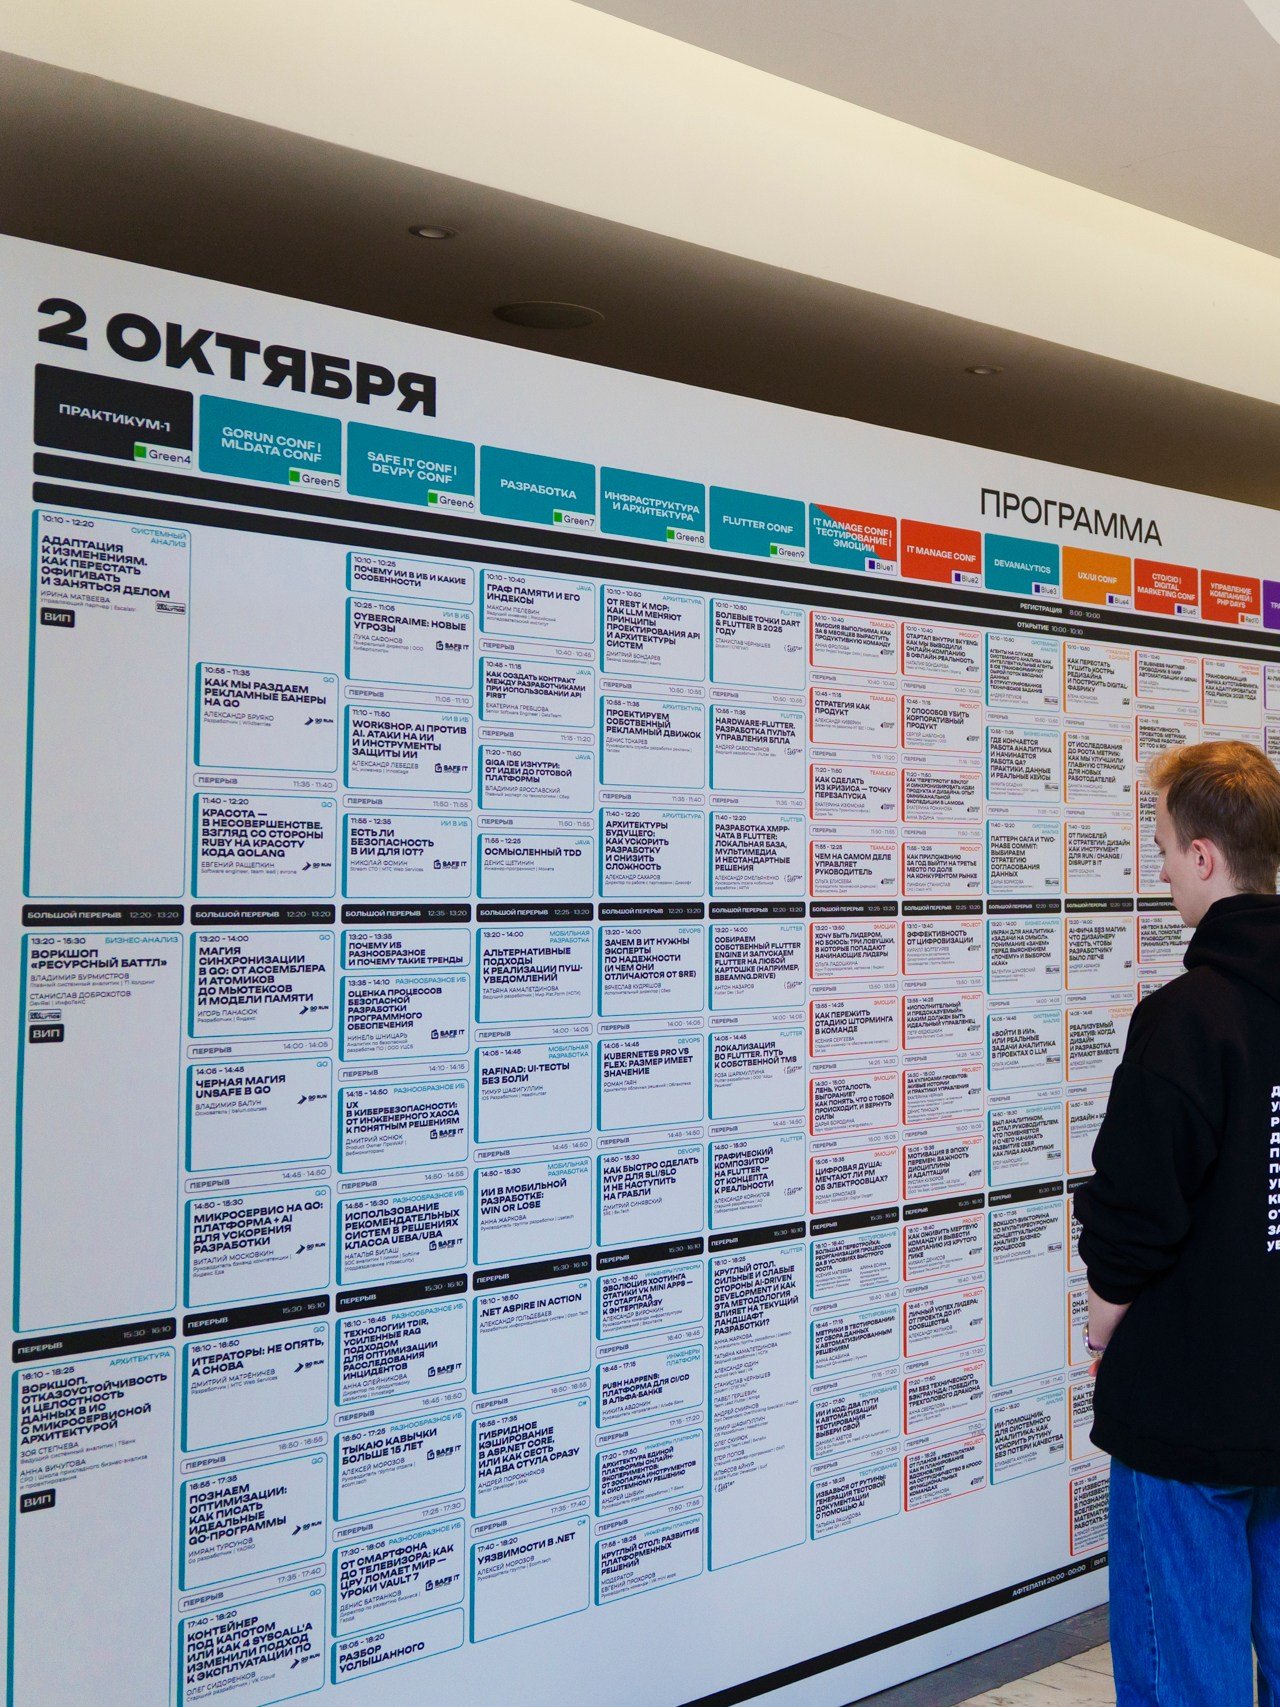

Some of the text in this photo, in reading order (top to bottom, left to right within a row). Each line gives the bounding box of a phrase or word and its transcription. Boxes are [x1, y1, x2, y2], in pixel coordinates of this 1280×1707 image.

[37, 297, 436, 418] 2 ОКТЯБРЯ
[59, 403, 170, 432] ПРАКТИКУМ-1
[222, 426, 315, 450] GORUN CONF
[148, 449, 191, 464] Green4
[221, 437, 322, 462] MLDATA CONF
[367, 451, 452, 473] SAFE IT CONF
[301, 473, 340, 488] Green5
[372, 462, 452, 484] DEVPY CONF
[500, 478, 576, 499] РАЗРАБОТКА
[439, 495, 474, 508] Green6
[604, 490, 700, 514] ИНФРАСТРУКТУРА
[612, 501, 694, 522] И АРХИТЕКТУРА
[981, 487, 1162, 546] ПРОГРАММА
[563, 514, 594, 526] Green7
[722, 515, 793, 533] FLUTTER CONF
[813, 517, 888, 536] IT MANAGE CONF
[130, 527, 186, 539] СИСТЕМНЫЙ
[675, 531, 704, 544] Green8
[815, 526, 887, 546] ТЕСТИРОВАНИЕ
[41, 535, 123, 553] АДАПТАЦИЯ
[150, 537, 186, 548] АНАЛИЗ
[833, 538, 874, 552] ЭМОЦИИ
[41, 545, 147, 566] К ИЗМЕНЕНИЯМ.
[778, 547, 805, 558] Green9
[906, 544, 976, 562] IT MANAGE CONF
[41, 555, 141, 575] КАК ПЕРЕСТАТЬ
[876, 562, 893, 571] Blue1
[994, 558, 1051, 574] DEVANALYTICS
[41, 565, 120, 583] ОФИГИВАТЬ
[1077, 571, 1117, 584] UX/UI CONF
[41, 575, 170, 598] И ЗАНЯТЬСЯ ДЕЛОМ
[1137, 585, 1195, 600] MARKETING CONF
[1153, 580, 1179, 591] DIGITAL
[40, 590, 110, 603] ИРИНА МАТВЕЕВА
[1019, 602, 1062, 613] РЕГИСТРАЦИЯ
[44, 612, 71, 622] ВИП
[814, 699, 854, 709] СТРАТЕГИЯ
[814, 706, 849, 716] ПРОДУКТ
[715, 724, 795, 737] РАЗРАБОТКА ПУЛЬТА
[715, 733, 790, 744] УПРАВЛЕНИЯ БПЛА
[990, 736, 1038, 745] ГДЕ КОНЧАЕТСЯ
[1014, 745, 1052, 753] АНАЛИТИКА
[27, 910, 77, 918] БОЛЬШОЙ
[31, 949, 98, 959] ВОРКШОП
[30, 957, 167, 969] «РЕСУРСНЫЙ БАТТЛ»
[191, 1337, 324, 1367] ИТЕРАТОРЫ: НЕ ОПЯТЬ,
[191, 1360, 244, 1377] А СНОВА
[477, 1539, 545, 1565] УЯЗВИМОСТИ
[547, 1537, 554, 1546] В
